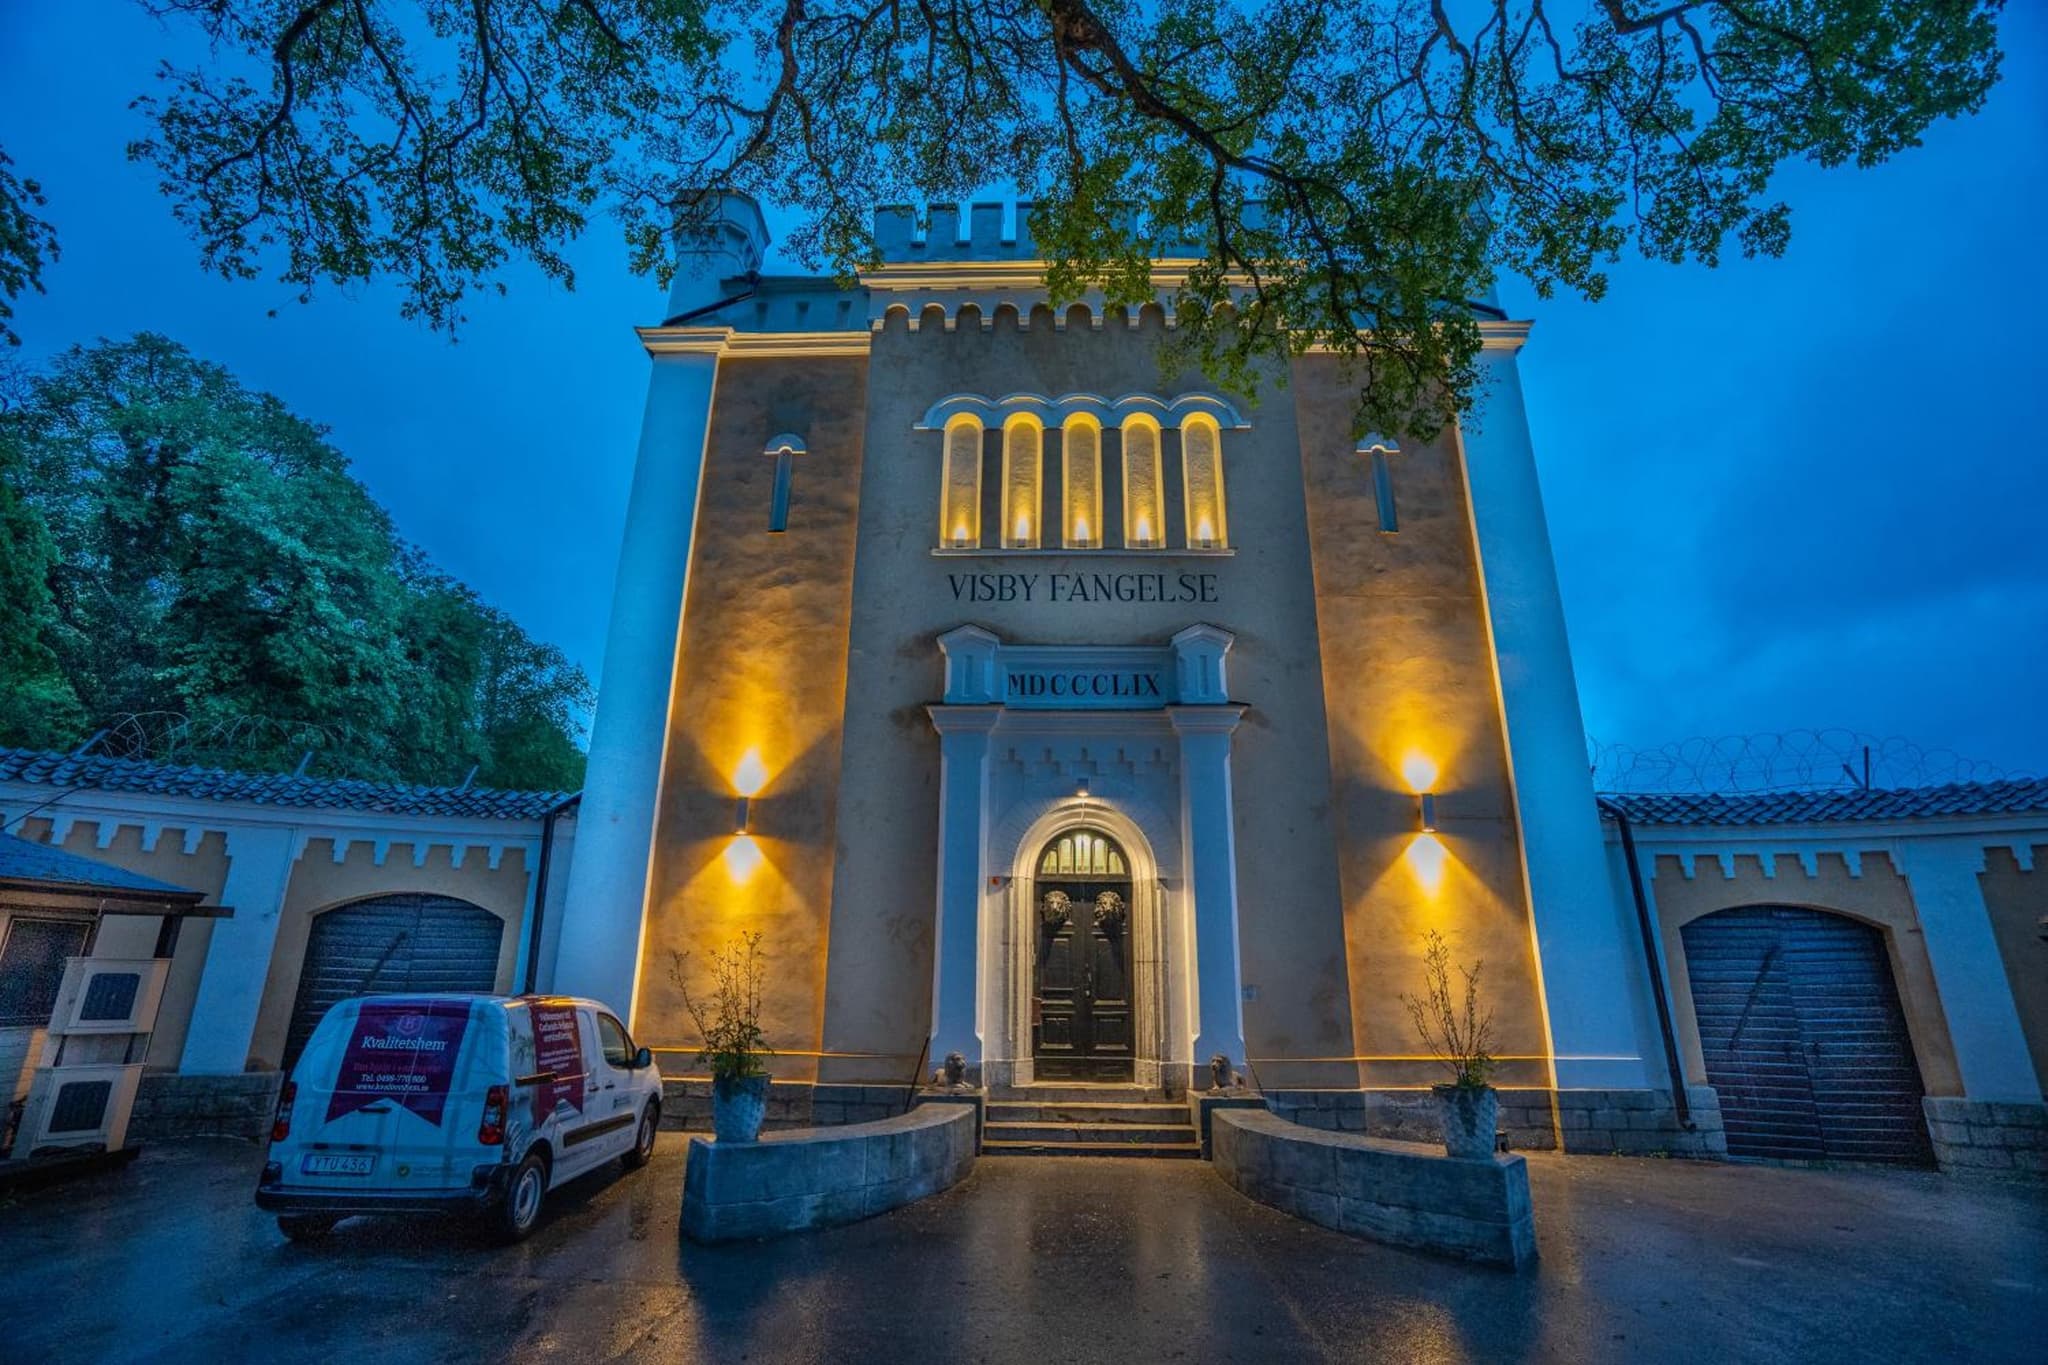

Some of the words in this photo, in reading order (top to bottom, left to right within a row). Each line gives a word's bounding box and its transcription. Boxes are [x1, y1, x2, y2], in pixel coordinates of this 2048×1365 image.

[948, 574, 1038, 602] VISBY
[1050, 572, 1219, 603] FÄNGELSE
[1008, 673, 1160, 697] MDCCCLIX
[361, 1035, 446, 1051] Kvalitetshem
